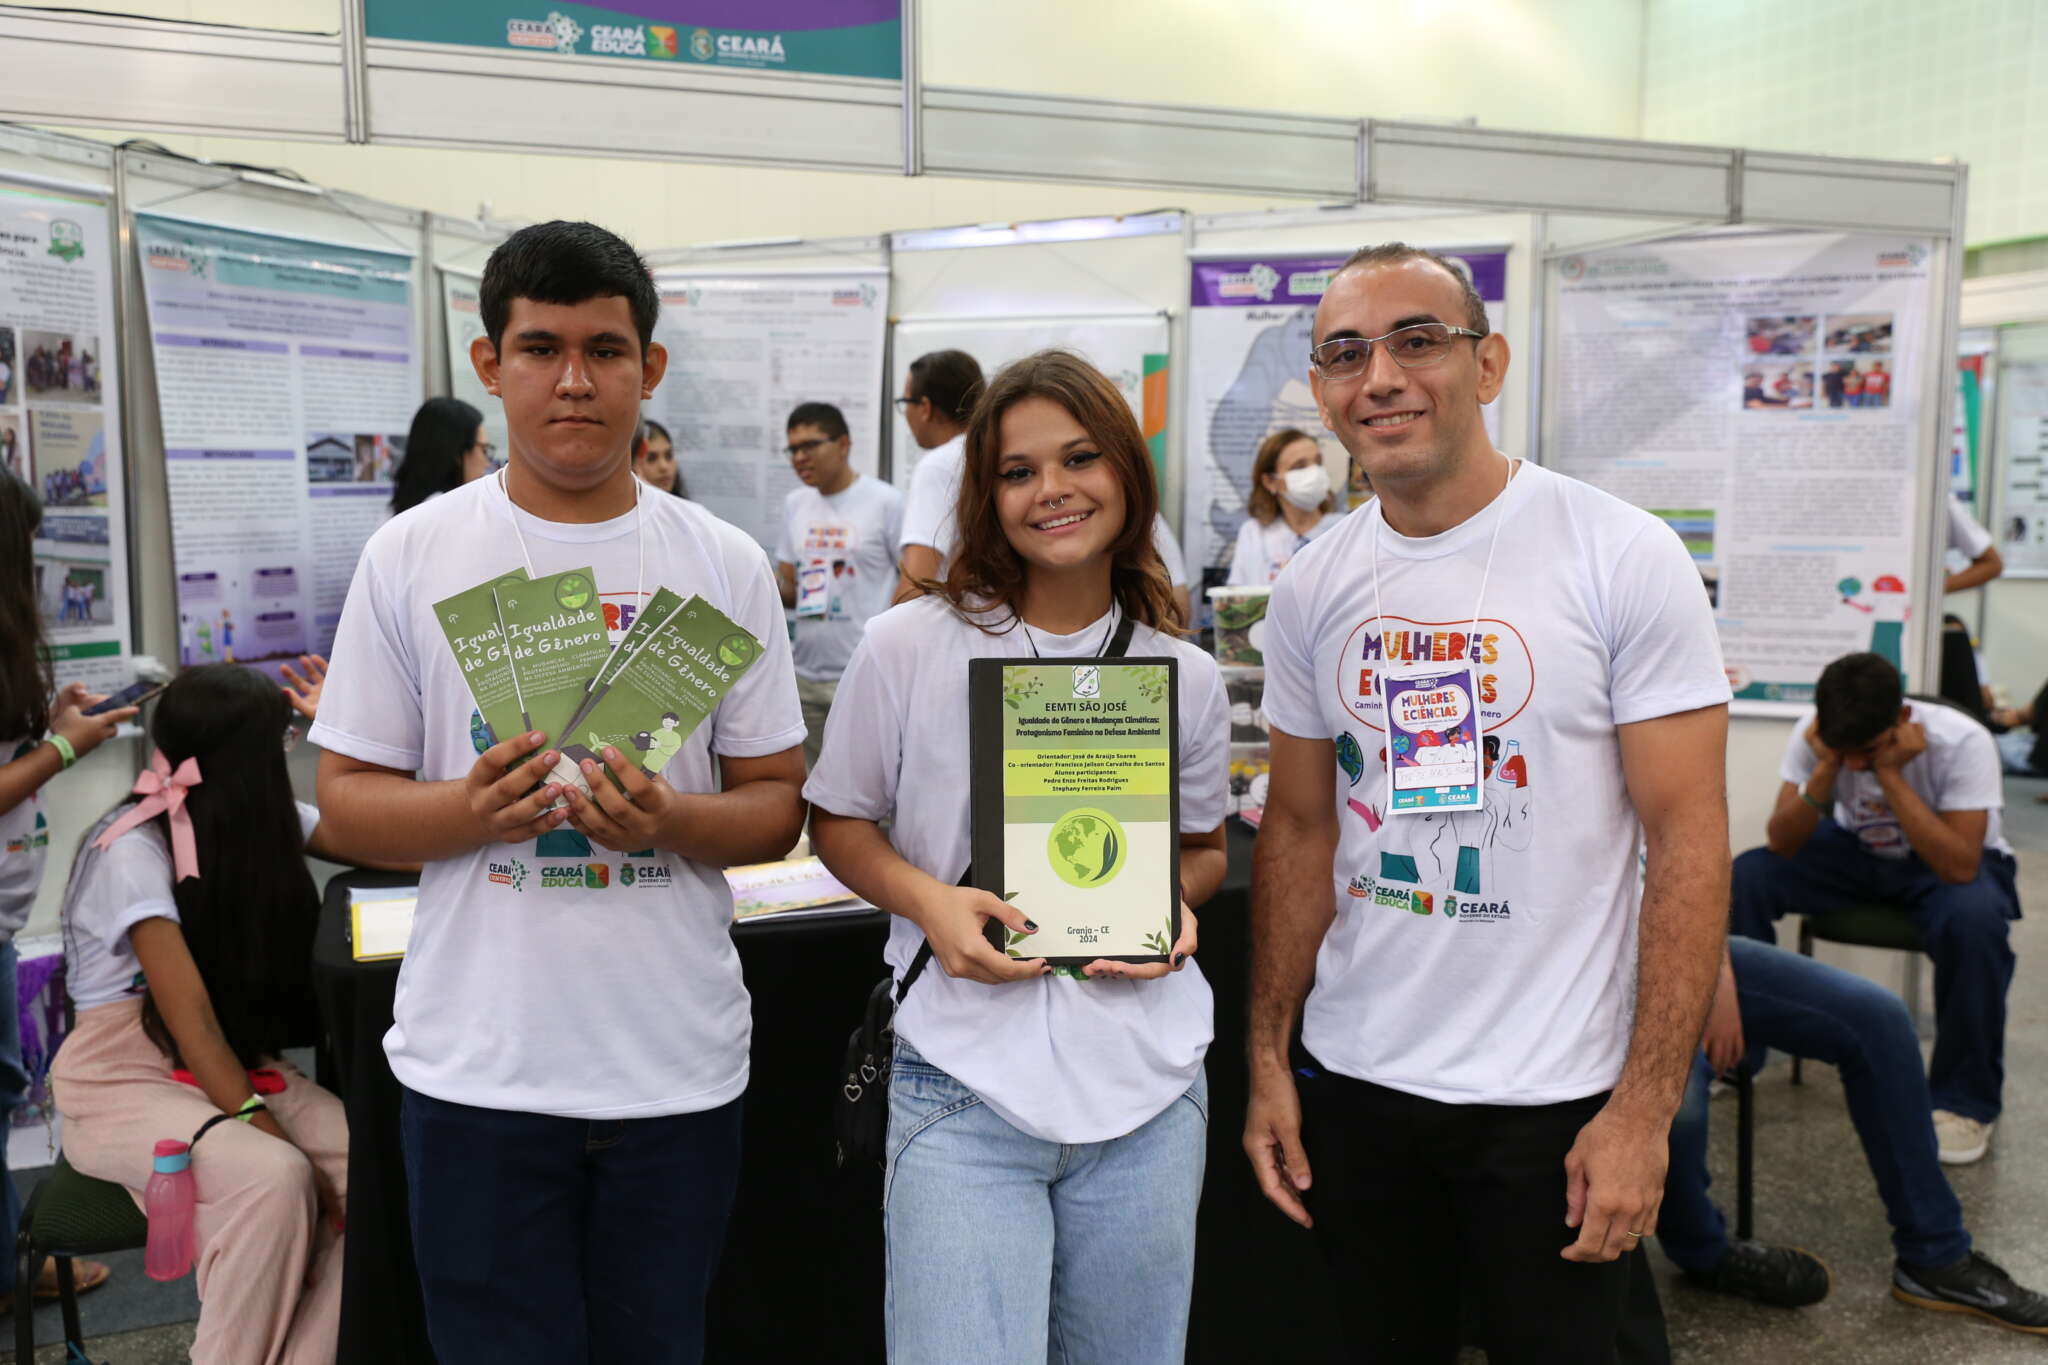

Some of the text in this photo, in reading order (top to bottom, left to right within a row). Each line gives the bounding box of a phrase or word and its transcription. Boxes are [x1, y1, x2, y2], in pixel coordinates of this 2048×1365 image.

[590, 24, 646, 42] CEARÁ
[590, 40, 646, 56] EDUCA
[717, 35, 785, 56] CEARÁ
[508, 609, 596, 643] Igualdade
[454, 622, 502, 654] Igual
[514, 645, 534, 660] de
[538, 632, 601, 654] Gênero
[662, 624, 730, 683] Igualdade
[1362, 631, 1500, 664] MULHERES
[648, 641, 666, 658] de
[668, 654, 716, 697] Gênero
[1359, 669, 1373, 696] E
[1045, 700, 1127, 714] EEMTI SÃO JOSÉ
[1402, 692, 1456, 707] MULHERES
[1355, 701, 1502, 719] Caminh nero
[1018, 716, 1050, 726] Igualdade
[1061, 716, 1084, 724] Gênero
[1091, 716, 1124, 726] Mudanças
[1124, 716, 1160, 724] Climáticas:
[1016, 728, 1062, 738] Protagonismo
[1064, 728, 1094, 736] Feminino
[1104, 728, 1126, 736] Defesa
[1128, 728, 1160, 736] Ambiental
[541, 863, 584, 878] CEARÁ
[541, 878, 584, 888] EDUCA
[1375, 886, 1410, 902] CEARÁ
[1374, 896, 1410, 911] EDUCA
[1460, 900, 1510, 914] CEARÁ
[1067, 926, 1092, 936] Granja
[1100, 926, 1110, 934] CE
[1080, 935, 1098, 944] 2024
